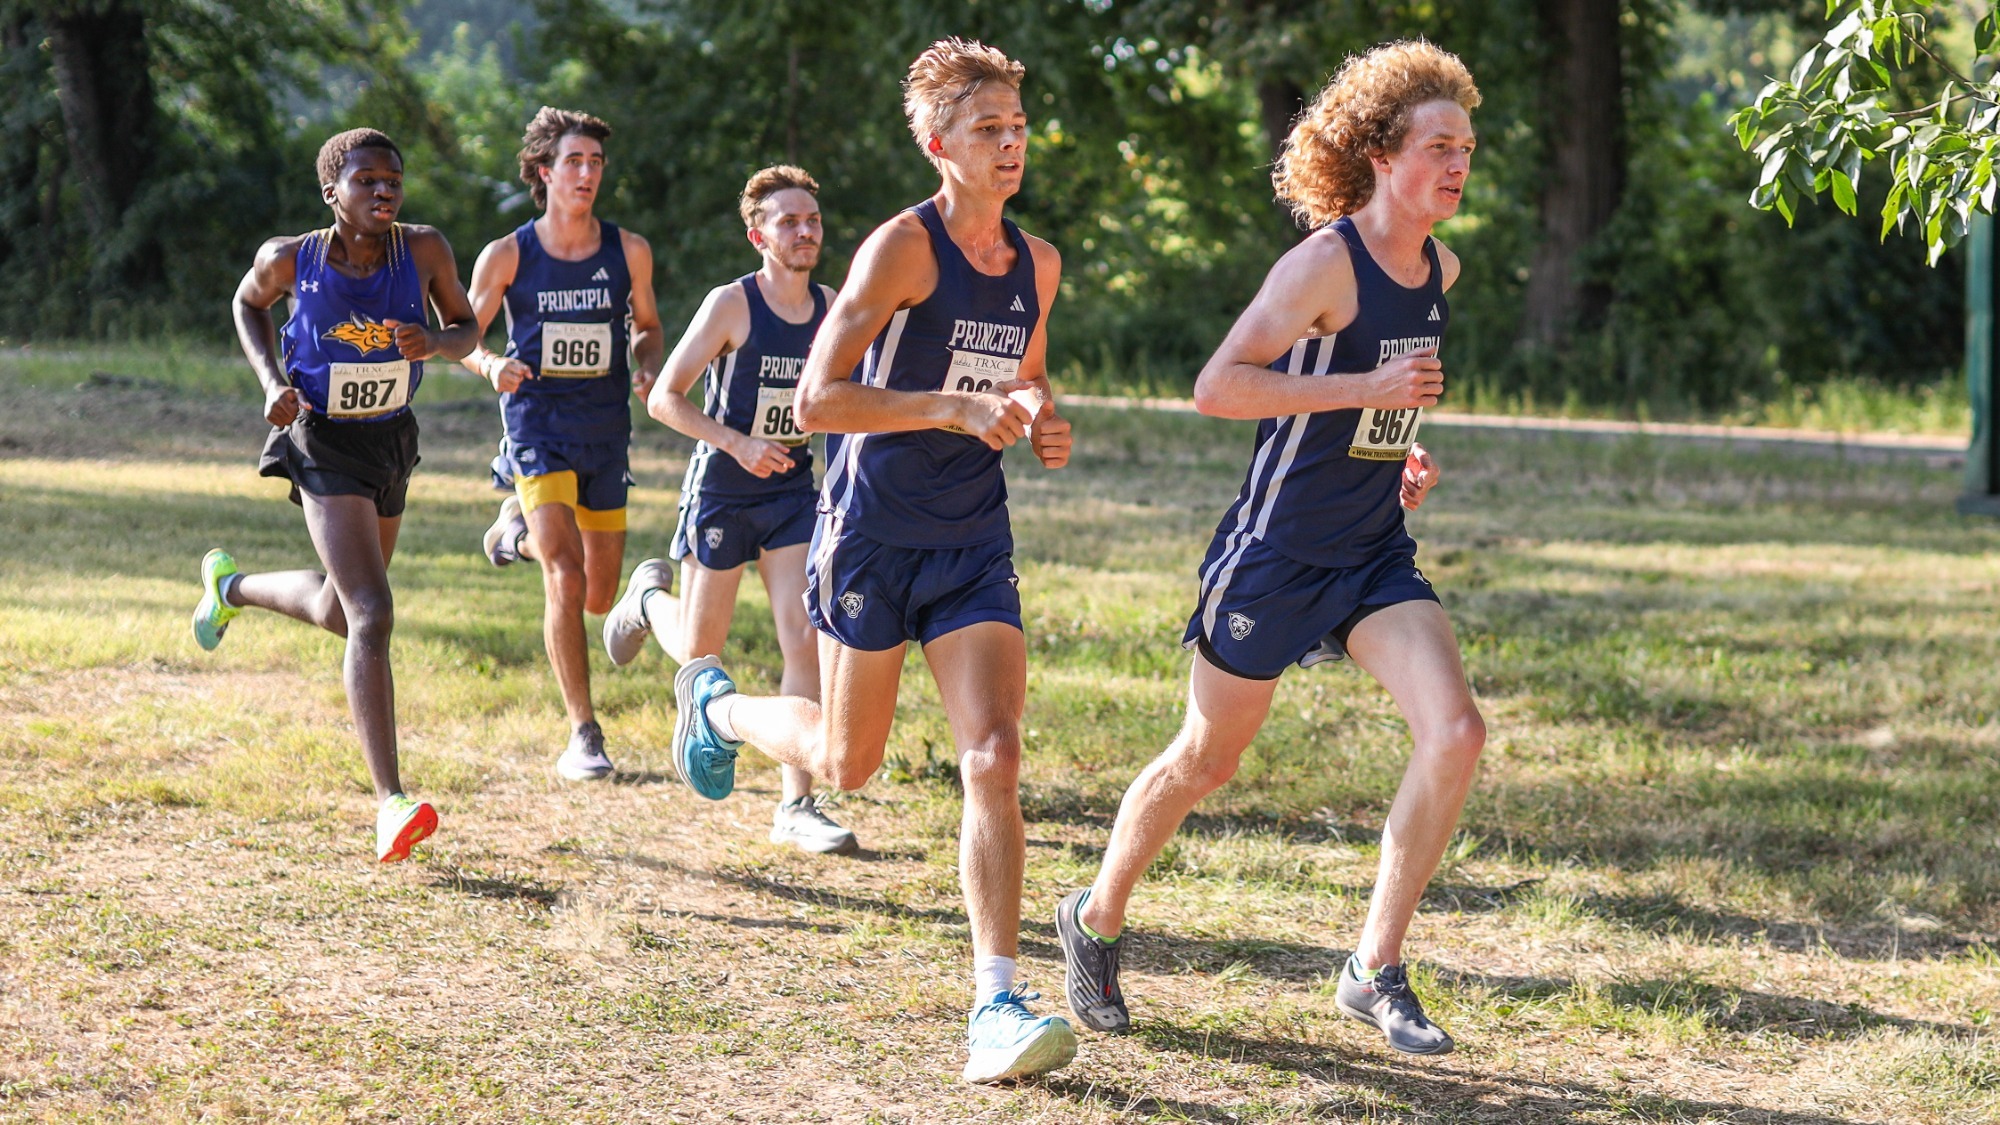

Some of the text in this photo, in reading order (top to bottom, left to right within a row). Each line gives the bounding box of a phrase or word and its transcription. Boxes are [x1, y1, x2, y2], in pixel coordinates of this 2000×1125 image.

[537, 288, 612, 313] PRINCIPIA
[552, 338, 600, 366] 966
[948, 319, 1027, 355] PRINCIPIA
[974, 357, 1005, 370] TRXC
[340, 378, 397, 410] 987
[1368, 408, 1418, 445] 967
